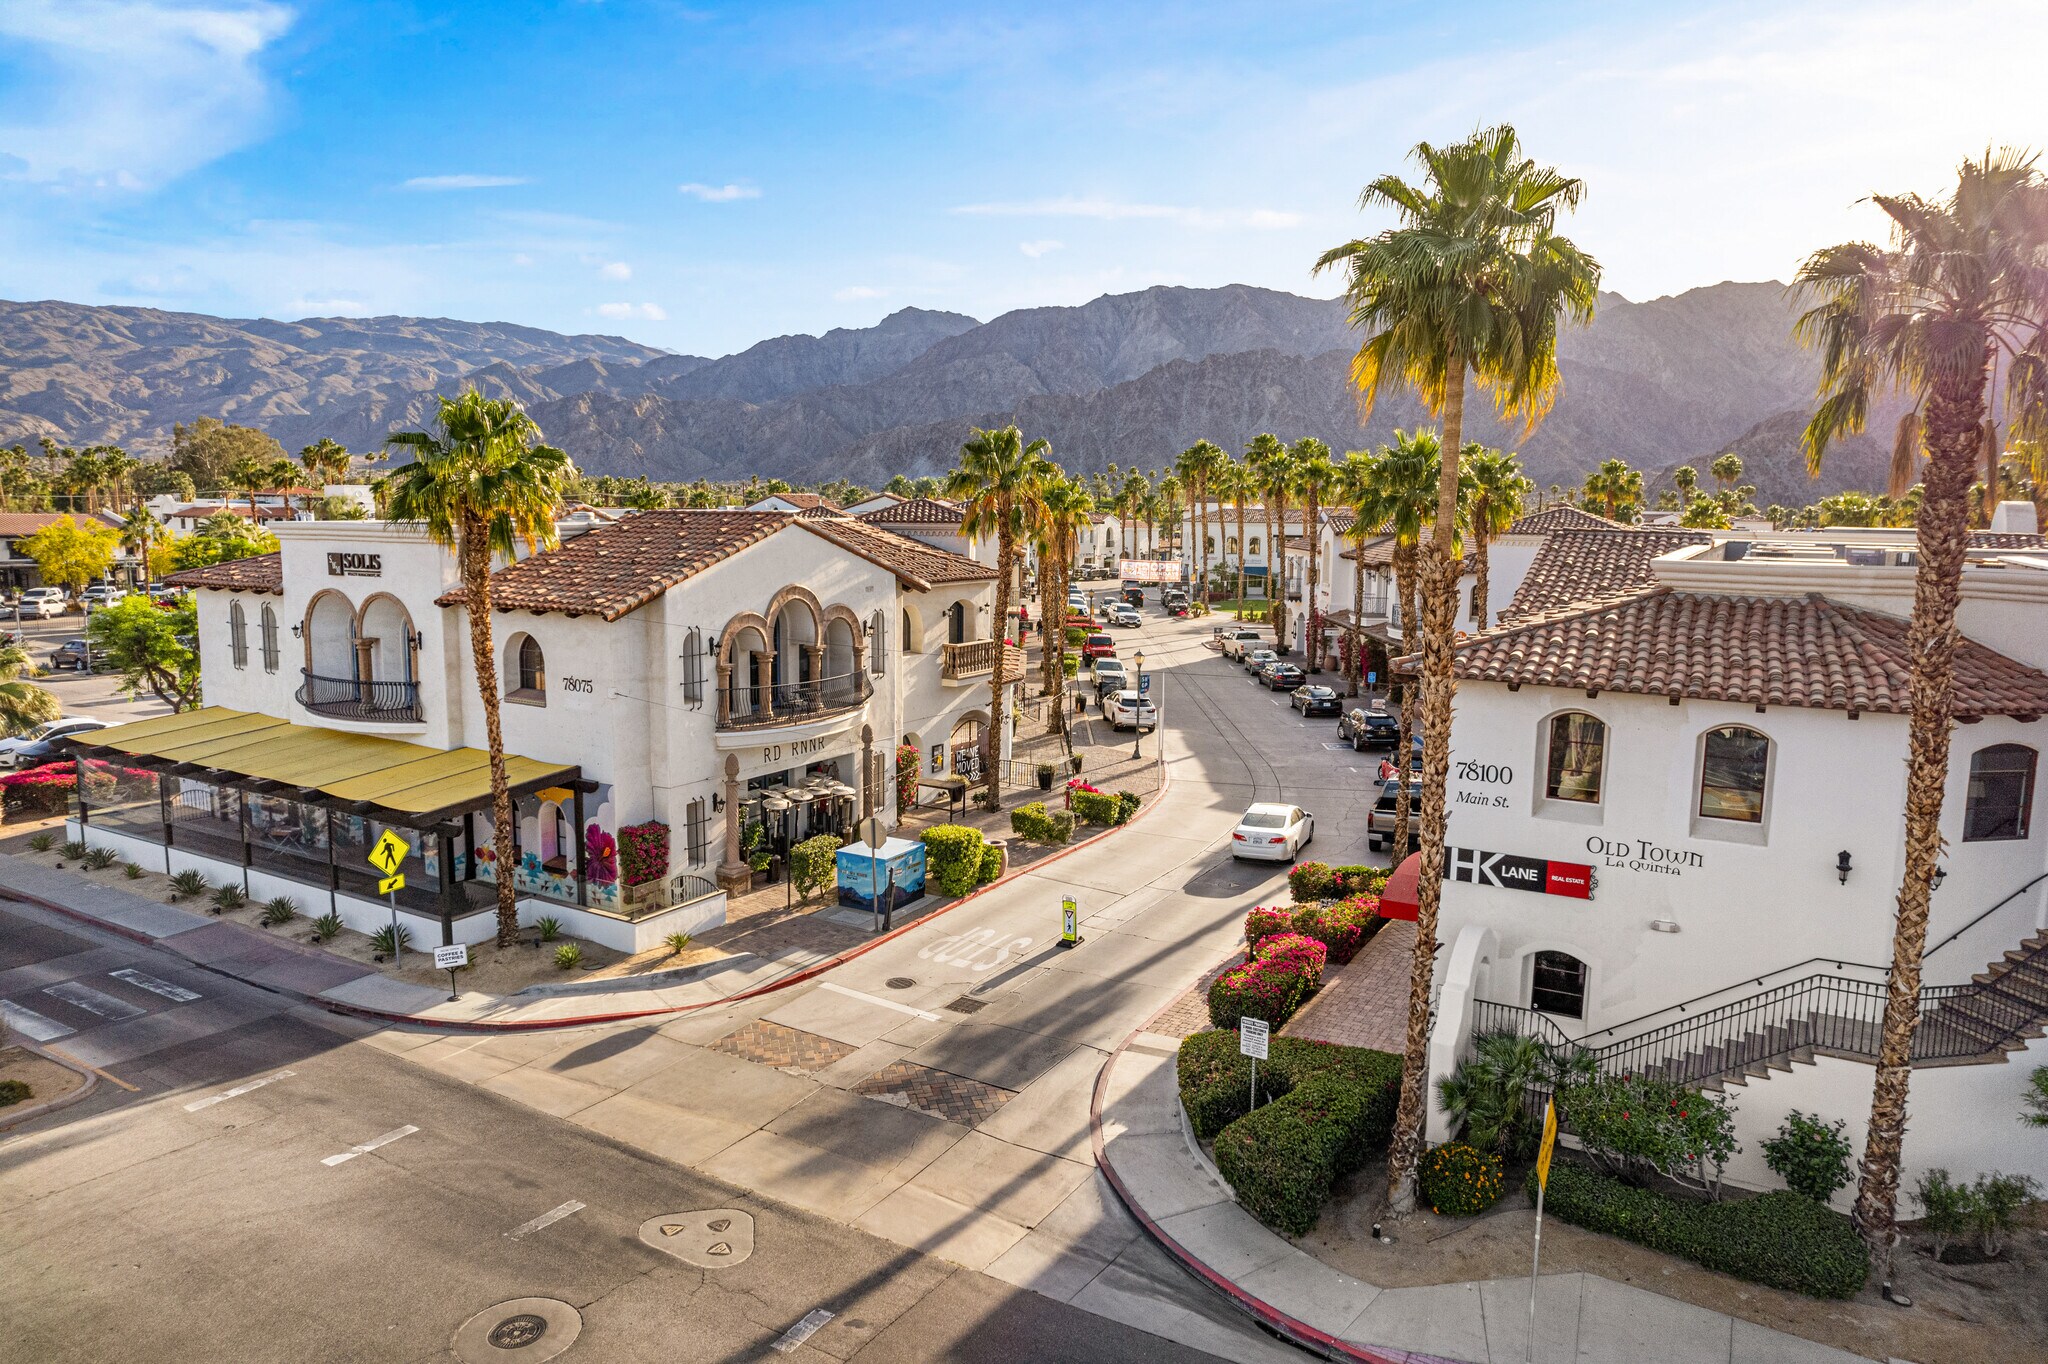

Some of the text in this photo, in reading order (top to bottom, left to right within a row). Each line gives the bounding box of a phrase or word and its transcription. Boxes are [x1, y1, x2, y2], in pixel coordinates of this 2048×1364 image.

[343, 553, 382, 570] SOLIS
[1150, 562, 1180, 572] OPEN
[562, 675, 593, 694] 78075
[763, 737, 825, 763] RD RNNR
[956, 758, 980, 774] MOVED
[1455, 759, 1513, 785] 78100
[1456, 791, 1510, 808] Main St.
[1450, 847, 1538, 888] HK LANE
[1551, 875, 1585, 885] REAL ESTATE
[917, 926, 1033, 971] STOP
